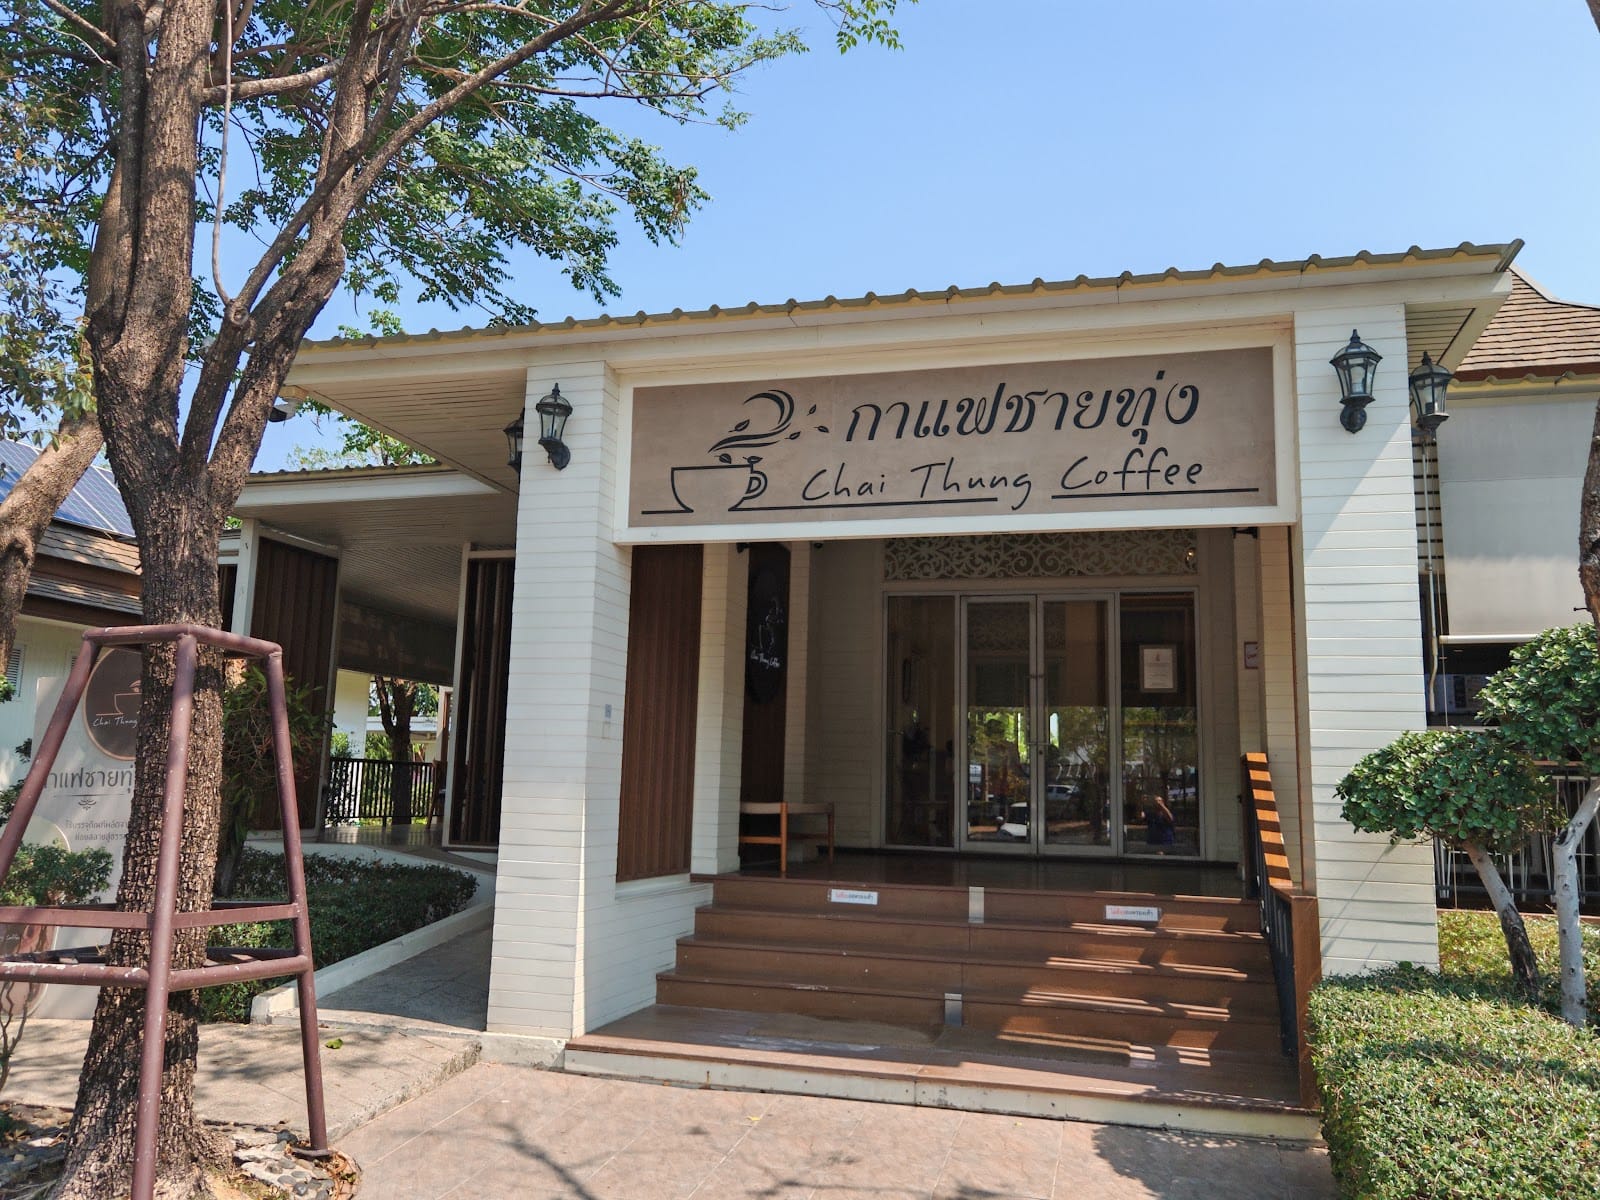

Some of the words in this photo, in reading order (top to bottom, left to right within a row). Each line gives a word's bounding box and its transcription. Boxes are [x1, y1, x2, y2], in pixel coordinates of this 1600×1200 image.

[845, 370, 1200, 445] กาแฟชายทุ่ง
[802, 461, 886, 501] Chai
[910, 456, 1032, 511] Thung
[1060, 446, 1203, 491] Coffee
[44, 764, 134, 794] าแฟชายทุ่
